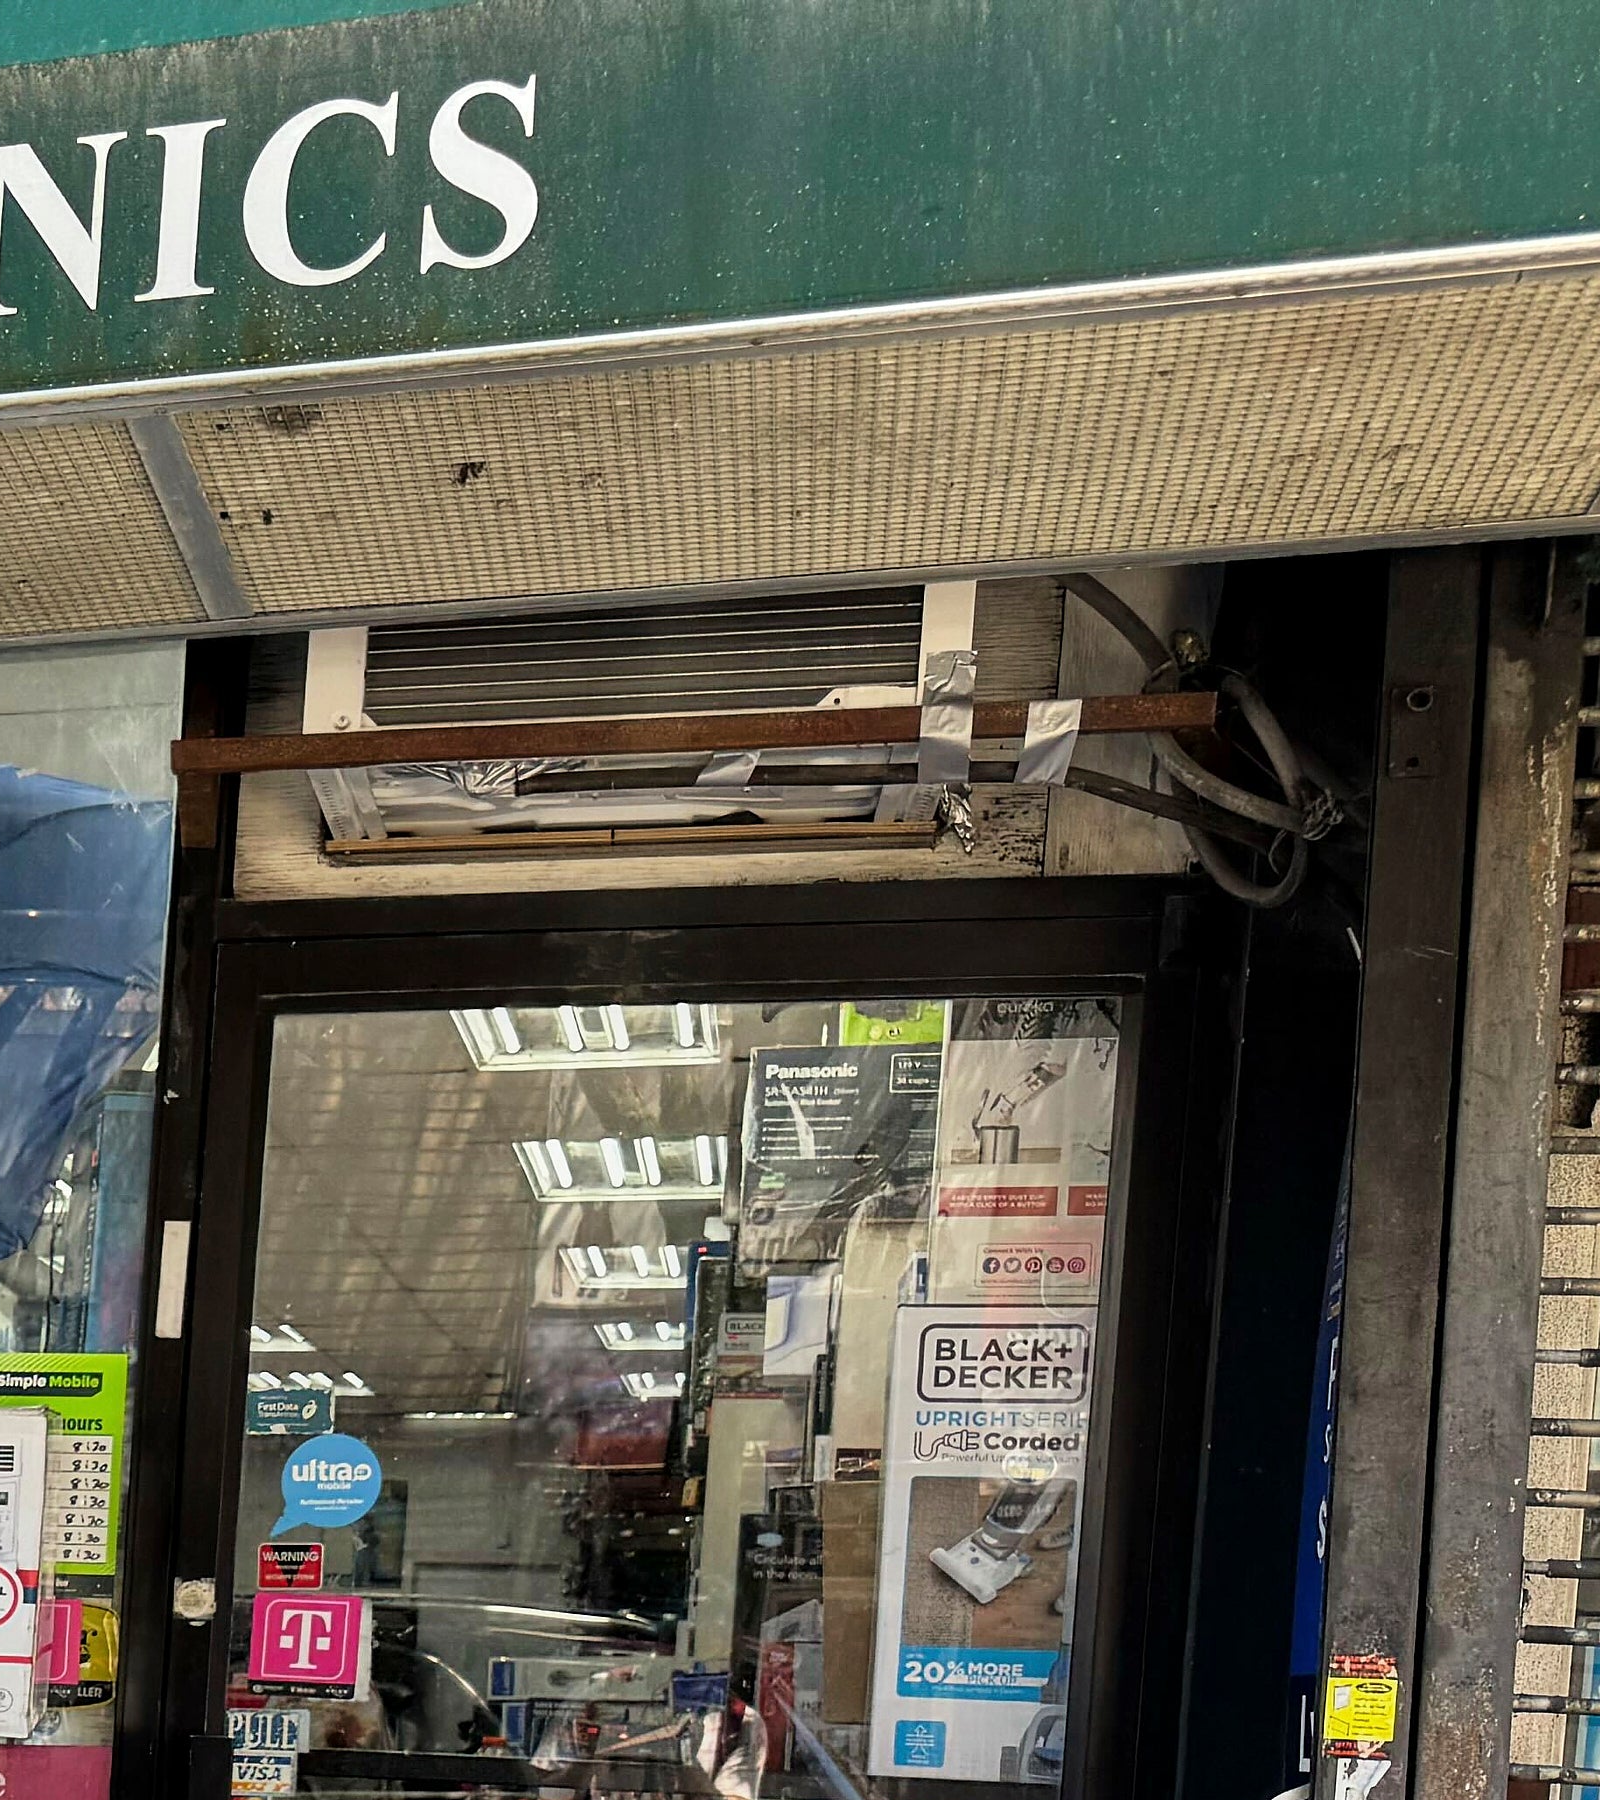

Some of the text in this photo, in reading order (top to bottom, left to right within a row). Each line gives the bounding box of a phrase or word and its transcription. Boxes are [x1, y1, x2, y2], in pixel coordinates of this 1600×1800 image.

[765, 1062, 859, 1081] Panasonic
[934, 1337, 1073, 1364] BLACK+
[49, 1374, 101, 1389] Mobile
[932, 1364, 1073, 1390] DECKER
[983, 1432, 1080, 1451] Corded
[262, 1551, 320, 1563] WARNING
[967, 1662, 1024, 1677] MORE
[236, 1764, 282, 1783] VISA
